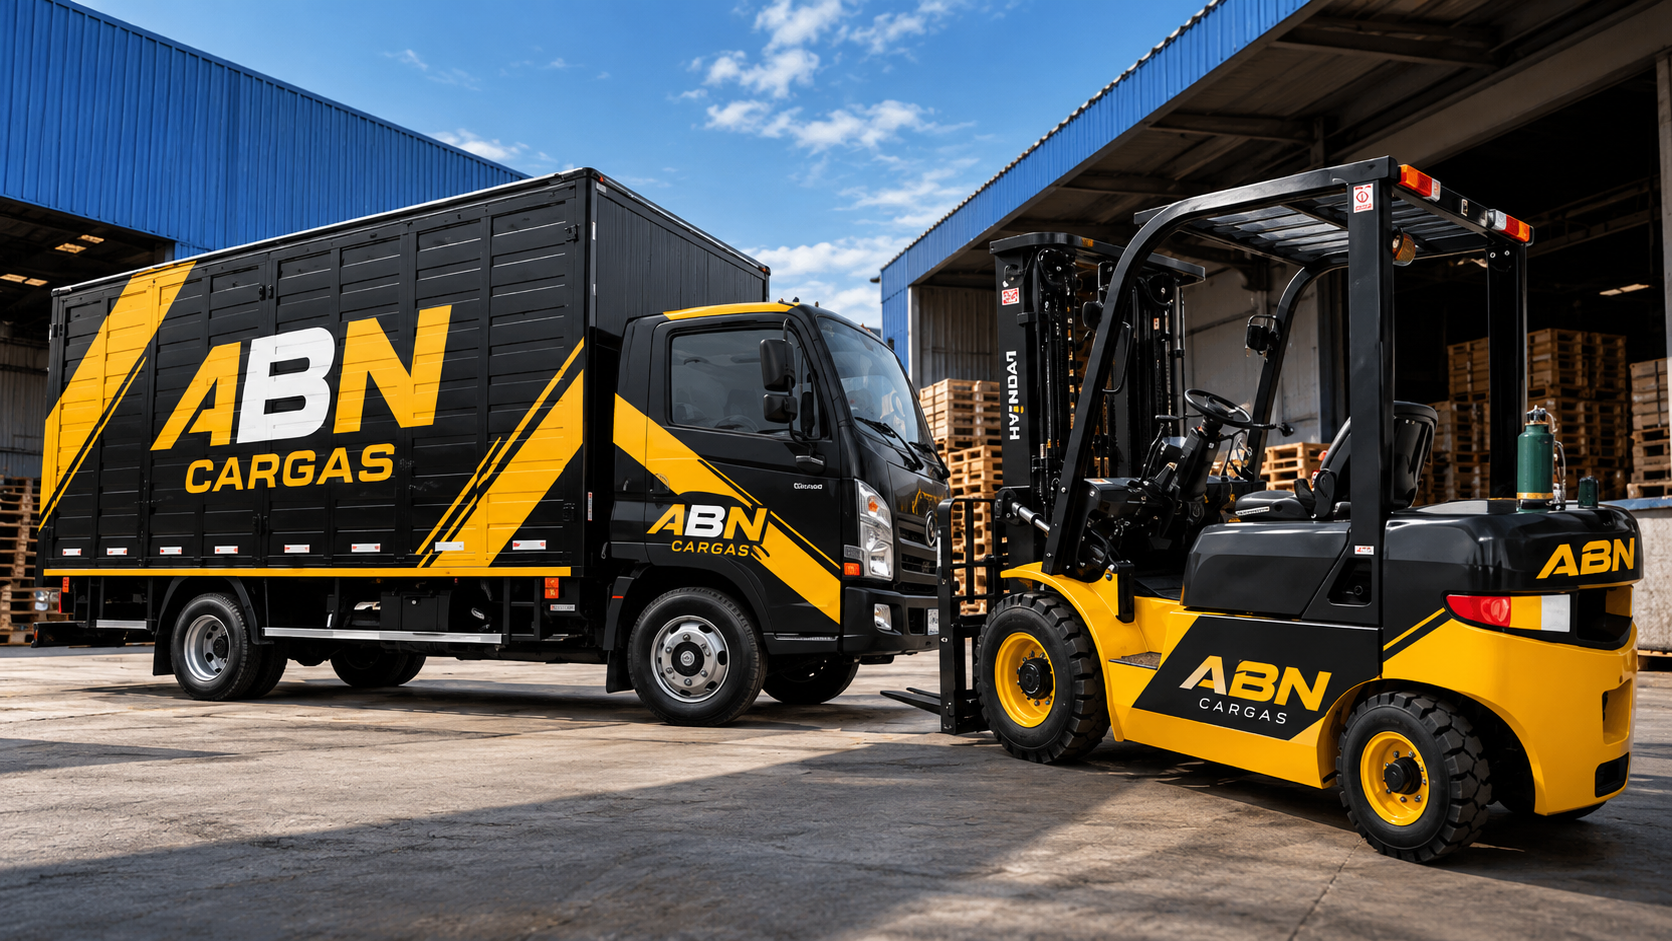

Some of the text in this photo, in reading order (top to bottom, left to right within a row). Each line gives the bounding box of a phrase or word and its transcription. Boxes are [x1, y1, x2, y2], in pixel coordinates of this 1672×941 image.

[150, 305, 452, 450] ABN
[185, 443, 395, 493] CARGAS
[646, 504, 768, 541] ABN
[671, 540, 750, 556] CARGAS
[1536, 537, 1635, 579] ABN
[1179, 655, 1332, 711] ABN
[1199, 698, 1287, 724] CARGAS
